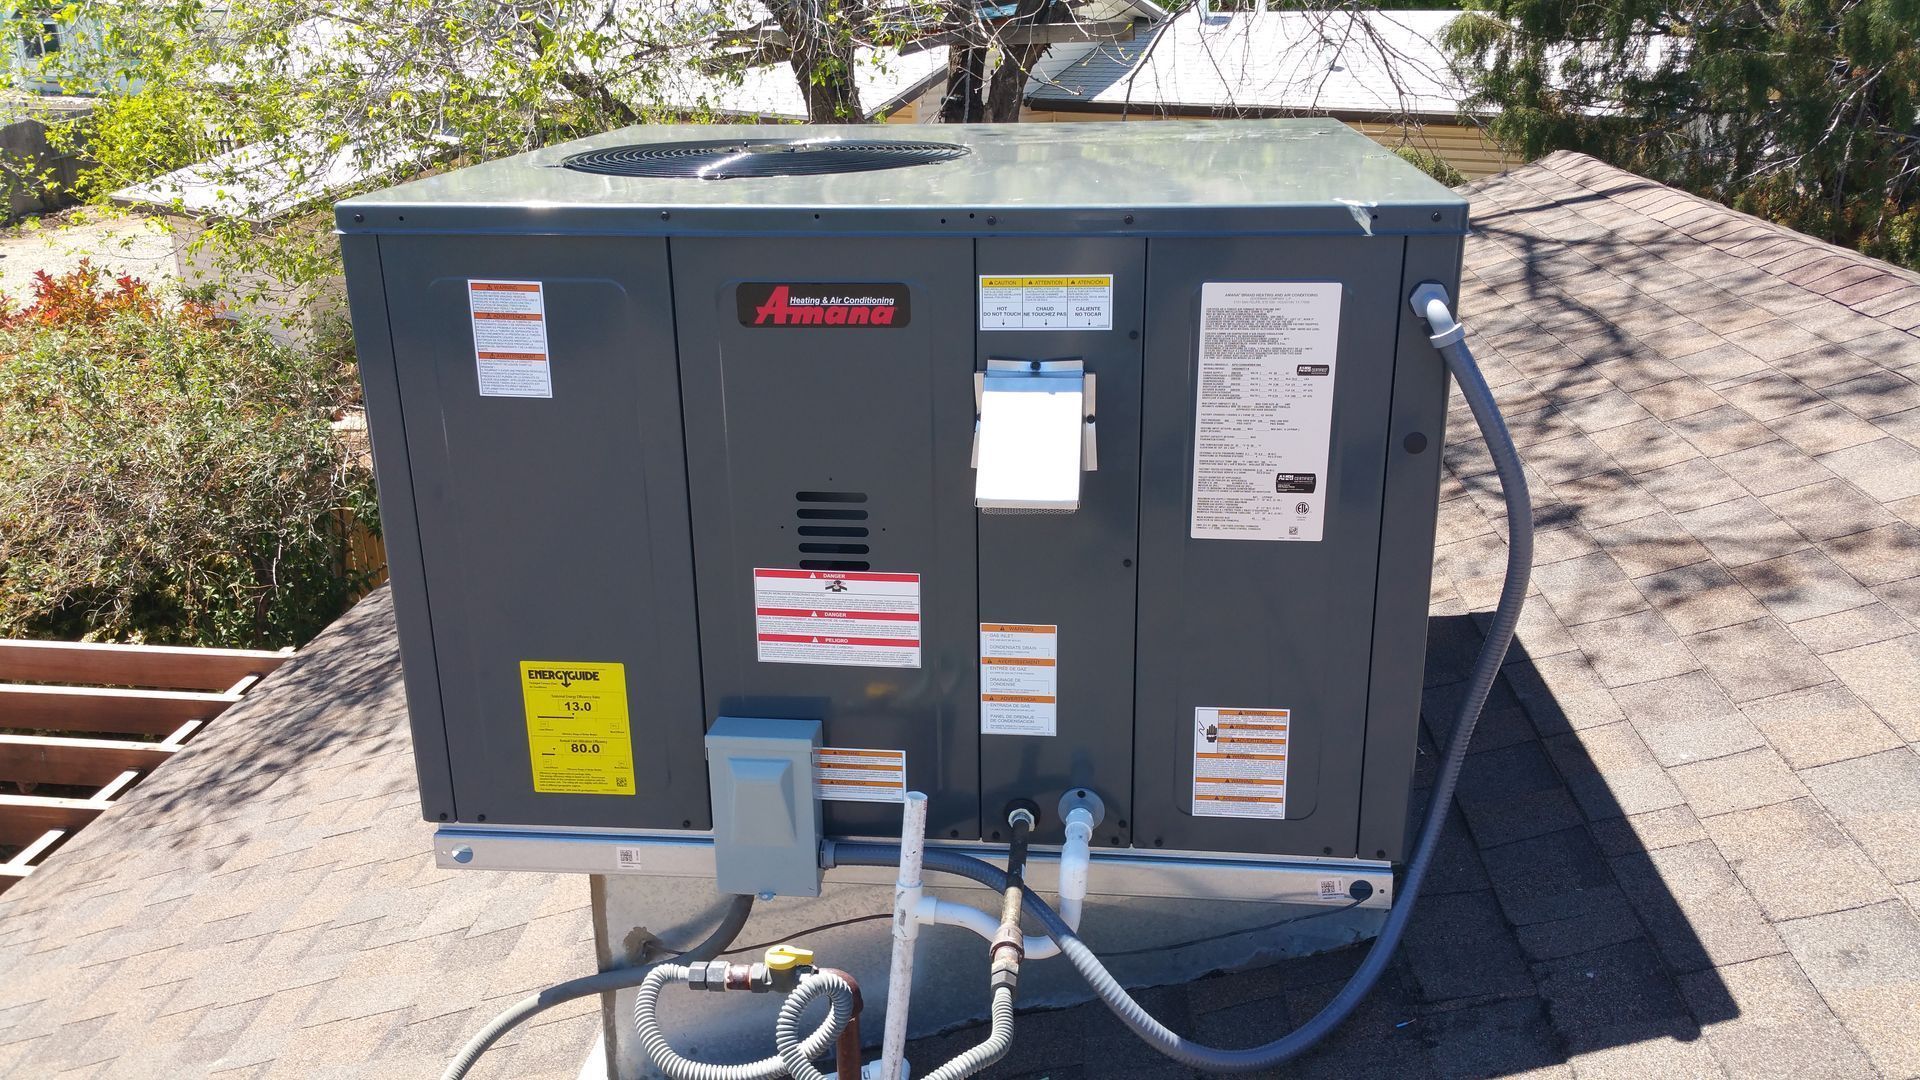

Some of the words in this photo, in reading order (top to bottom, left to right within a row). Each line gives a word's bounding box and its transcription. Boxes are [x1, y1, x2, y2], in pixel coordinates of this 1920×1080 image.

[754, 285, 896, 325] Amana
[790, 296, 820, 306] Heating
[822, 296, 828, 305] &
[830, 296, 843, 305] Air
[843, 296, 894, 306] Conditioning
[528, 669, 600, 682] ENERGYGUIDE
[565, 701, 592, 712] 13.0
[571, 743, 600, 754] 80.0
